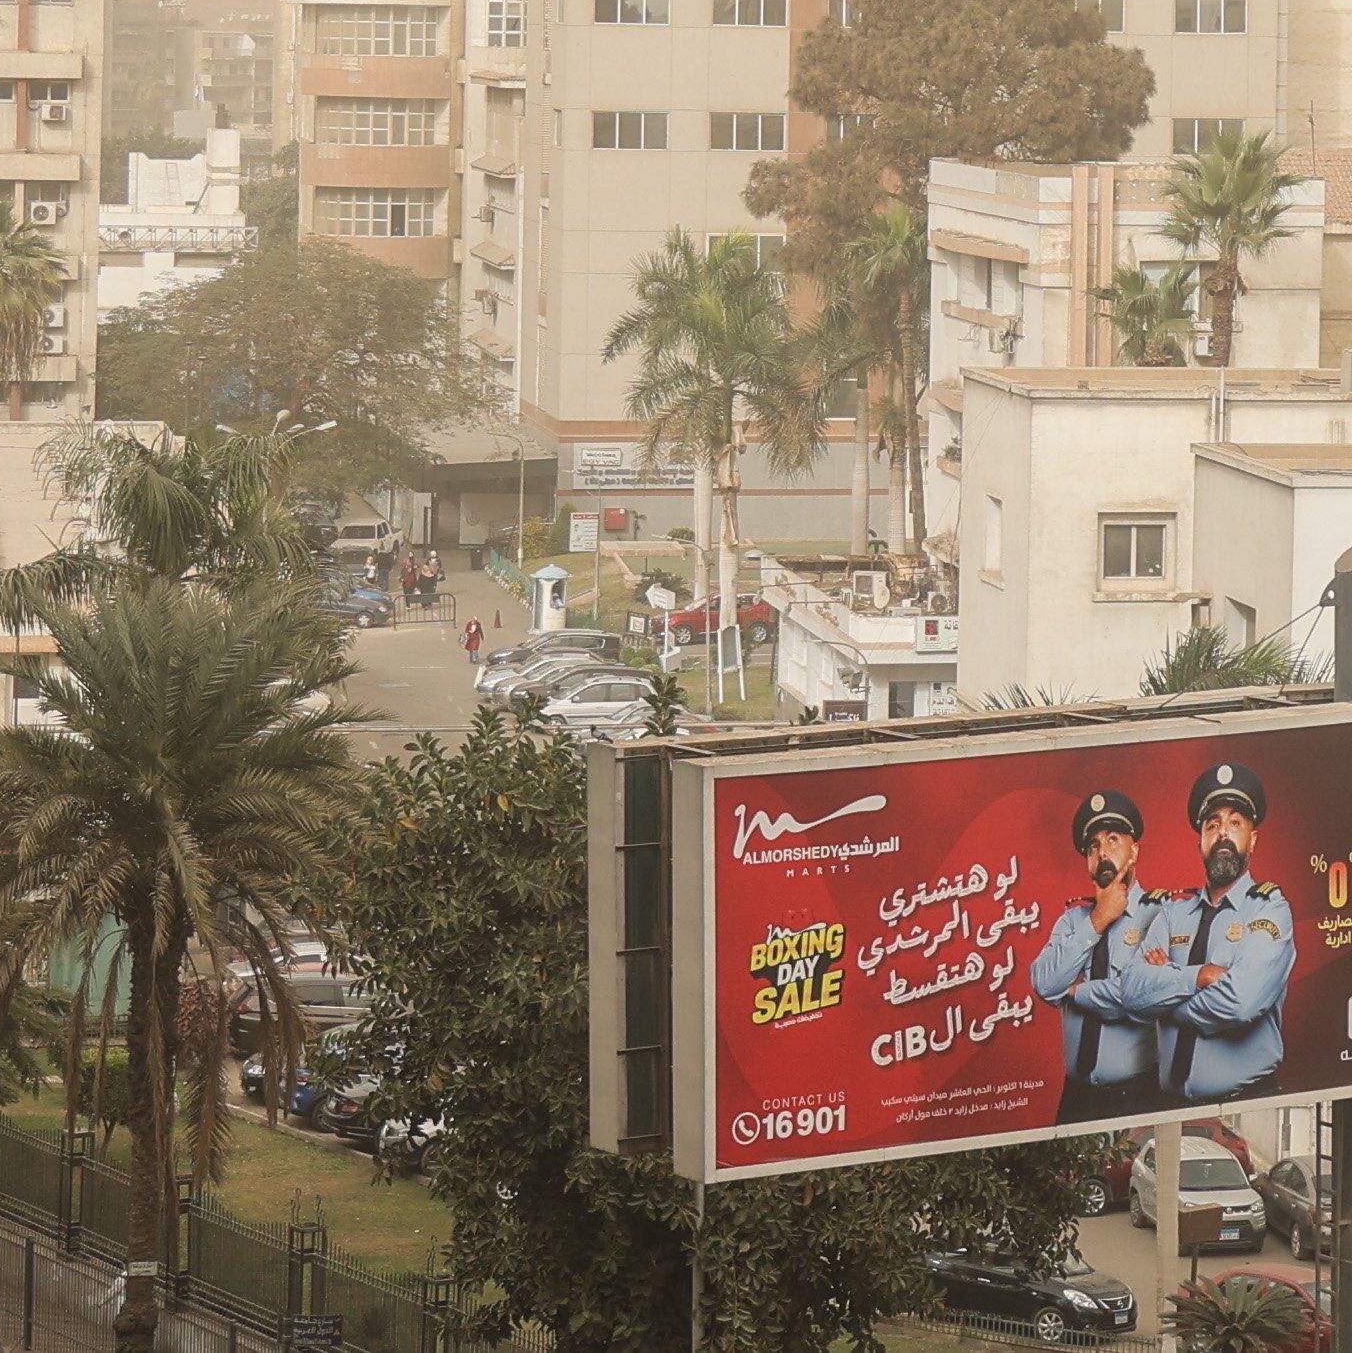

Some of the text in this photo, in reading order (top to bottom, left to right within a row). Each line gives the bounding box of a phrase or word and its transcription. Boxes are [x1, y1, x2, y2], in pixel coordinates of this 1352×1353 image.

[743, 846, 838, 865] ALMORSHEDY
[837, 836, 900, 861] المرشدي
[786, 864, 851, 878] MARTS
[878, 855, 1019, 928] لو هتشتري
[750, 923, 845, 972] BOXING
[857, 899, 971, 977] المرشدي
[1325, 930, 1352, 948] ادارية
[777, 955, 821, 987] DAY
[882, 945, 1016, 1006] لو هتقسط
[752, 969, 843, 1025] SALE
[763, 1091, 846, 1110] CONTACT US
